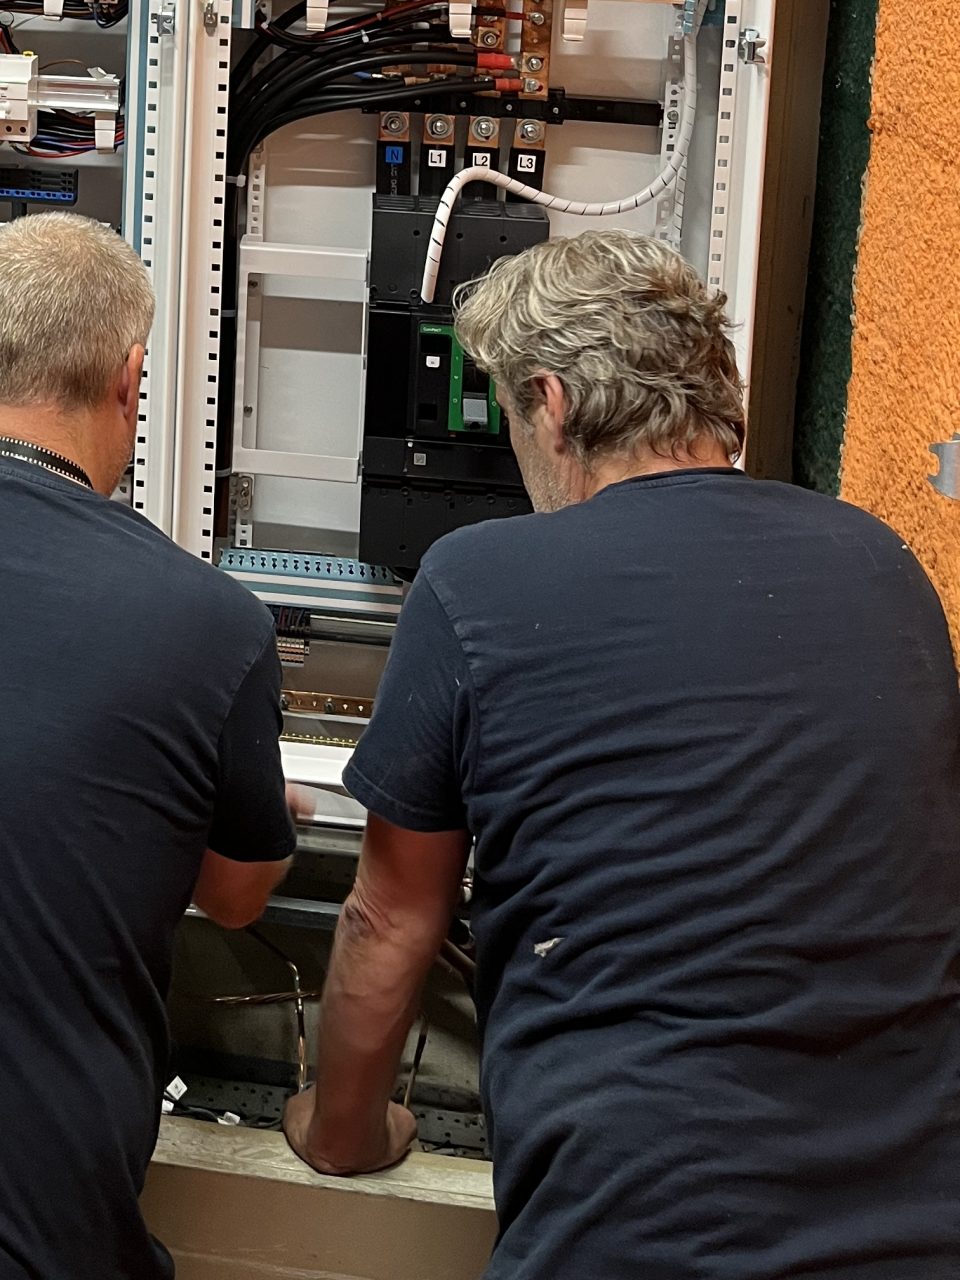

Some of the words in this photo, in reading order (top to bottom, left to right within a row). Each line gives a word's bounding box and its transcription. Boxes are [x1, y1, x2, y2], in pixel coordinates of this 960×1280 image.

[390, 148, 399, 161] N
[430, 151, 443, 164] L1
[474, 154, 488, 167] L2
[519, 157, 534, 169] L3
